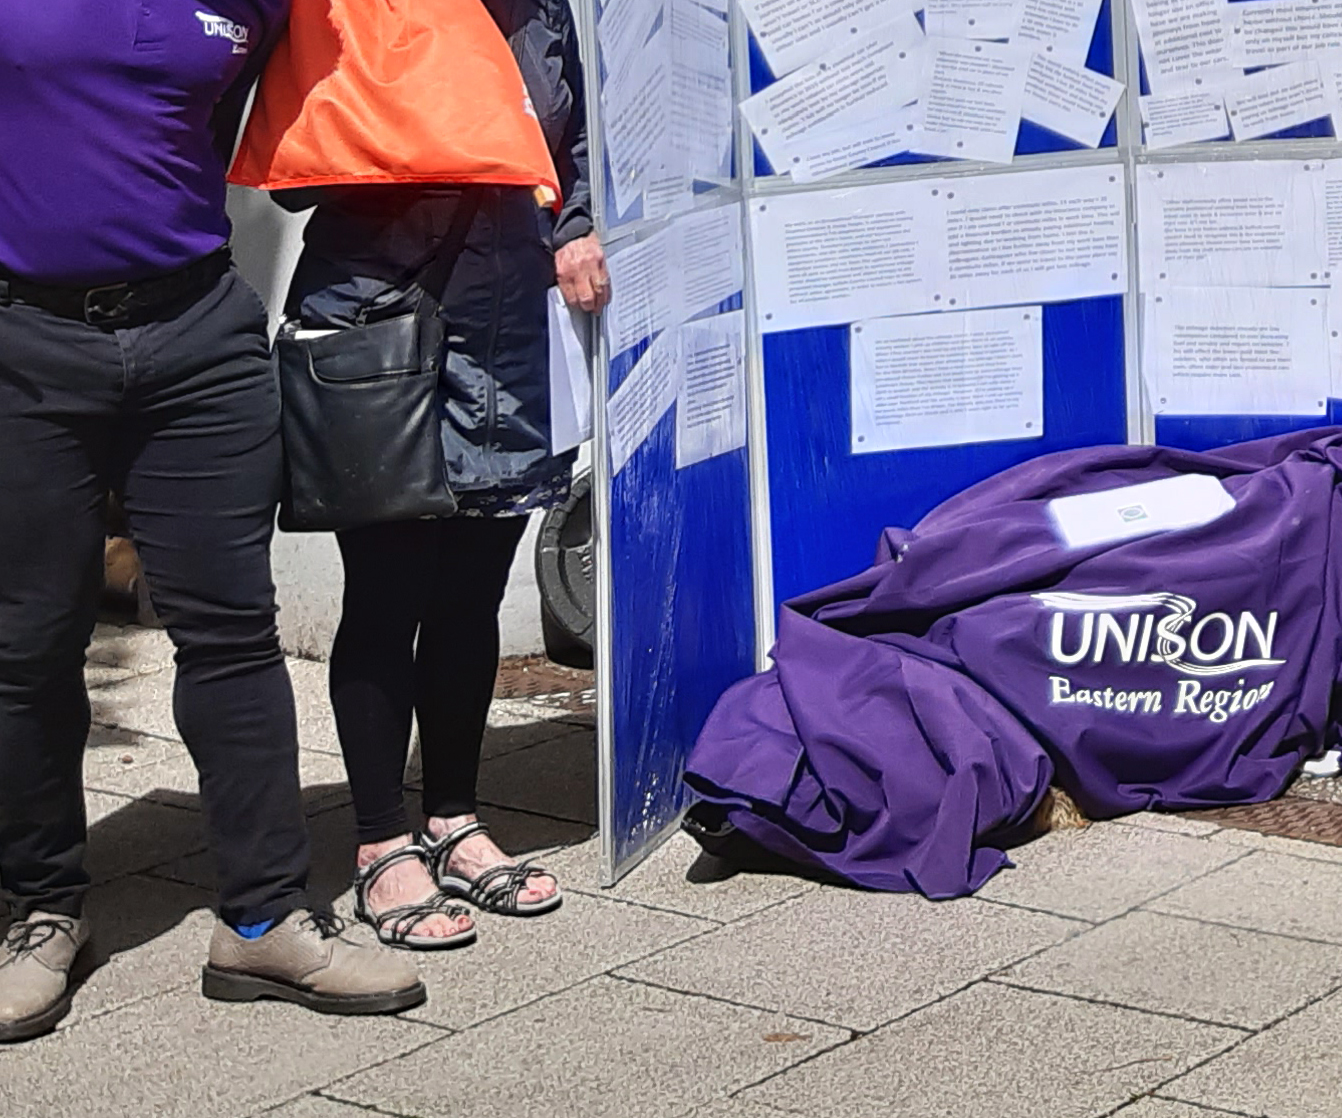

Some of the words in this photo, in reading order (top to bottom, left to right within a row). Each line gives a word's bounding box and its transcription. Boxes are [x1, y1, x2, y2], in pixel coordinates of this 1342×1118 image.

[1051, 610, 1278, 664] UNISON
[1049, 676, 1162, 713] Eastern
[1175, 679, 1274, 724] Region
